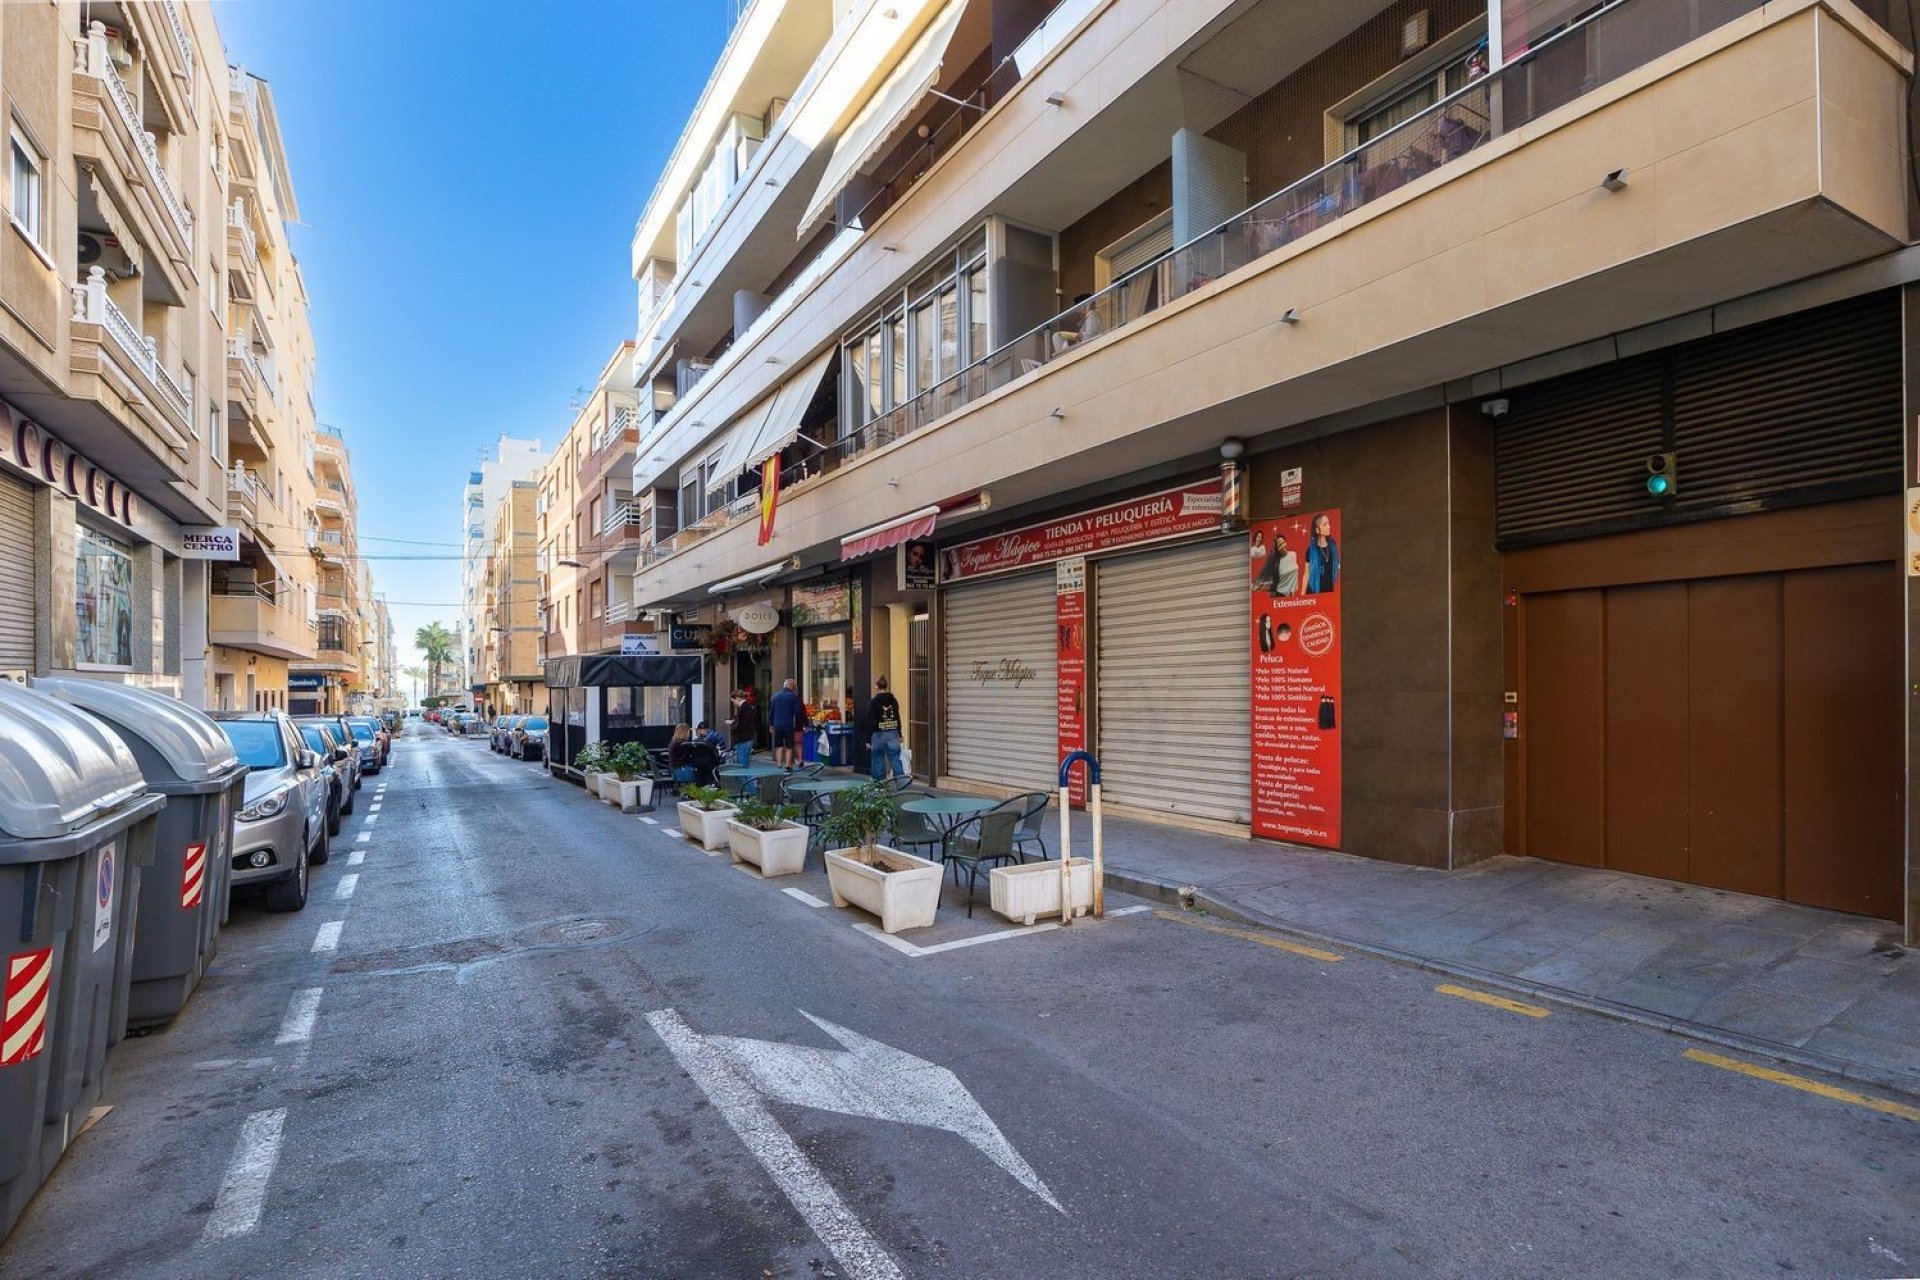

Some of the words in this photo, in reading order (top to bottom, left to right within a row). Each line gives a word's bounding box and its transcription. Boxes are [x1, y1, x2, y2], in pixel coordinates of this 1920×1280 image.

[1046, 521, 1084, 539] TIENDA
[1086, 518, 1094, 530] Y
[1096, 497, 1173, 528] PELUQUERÍA
[184, 534, 233, 544] MERCA
[183, 542, 234, 552] CENTRO
[960, 545, 992, 572] Toque
[1273, 597, 1316, 608] Extensiones
[1306, 637, 1330, 648] CALIDAD
[1260, 654, 1284, 663] Peluca
